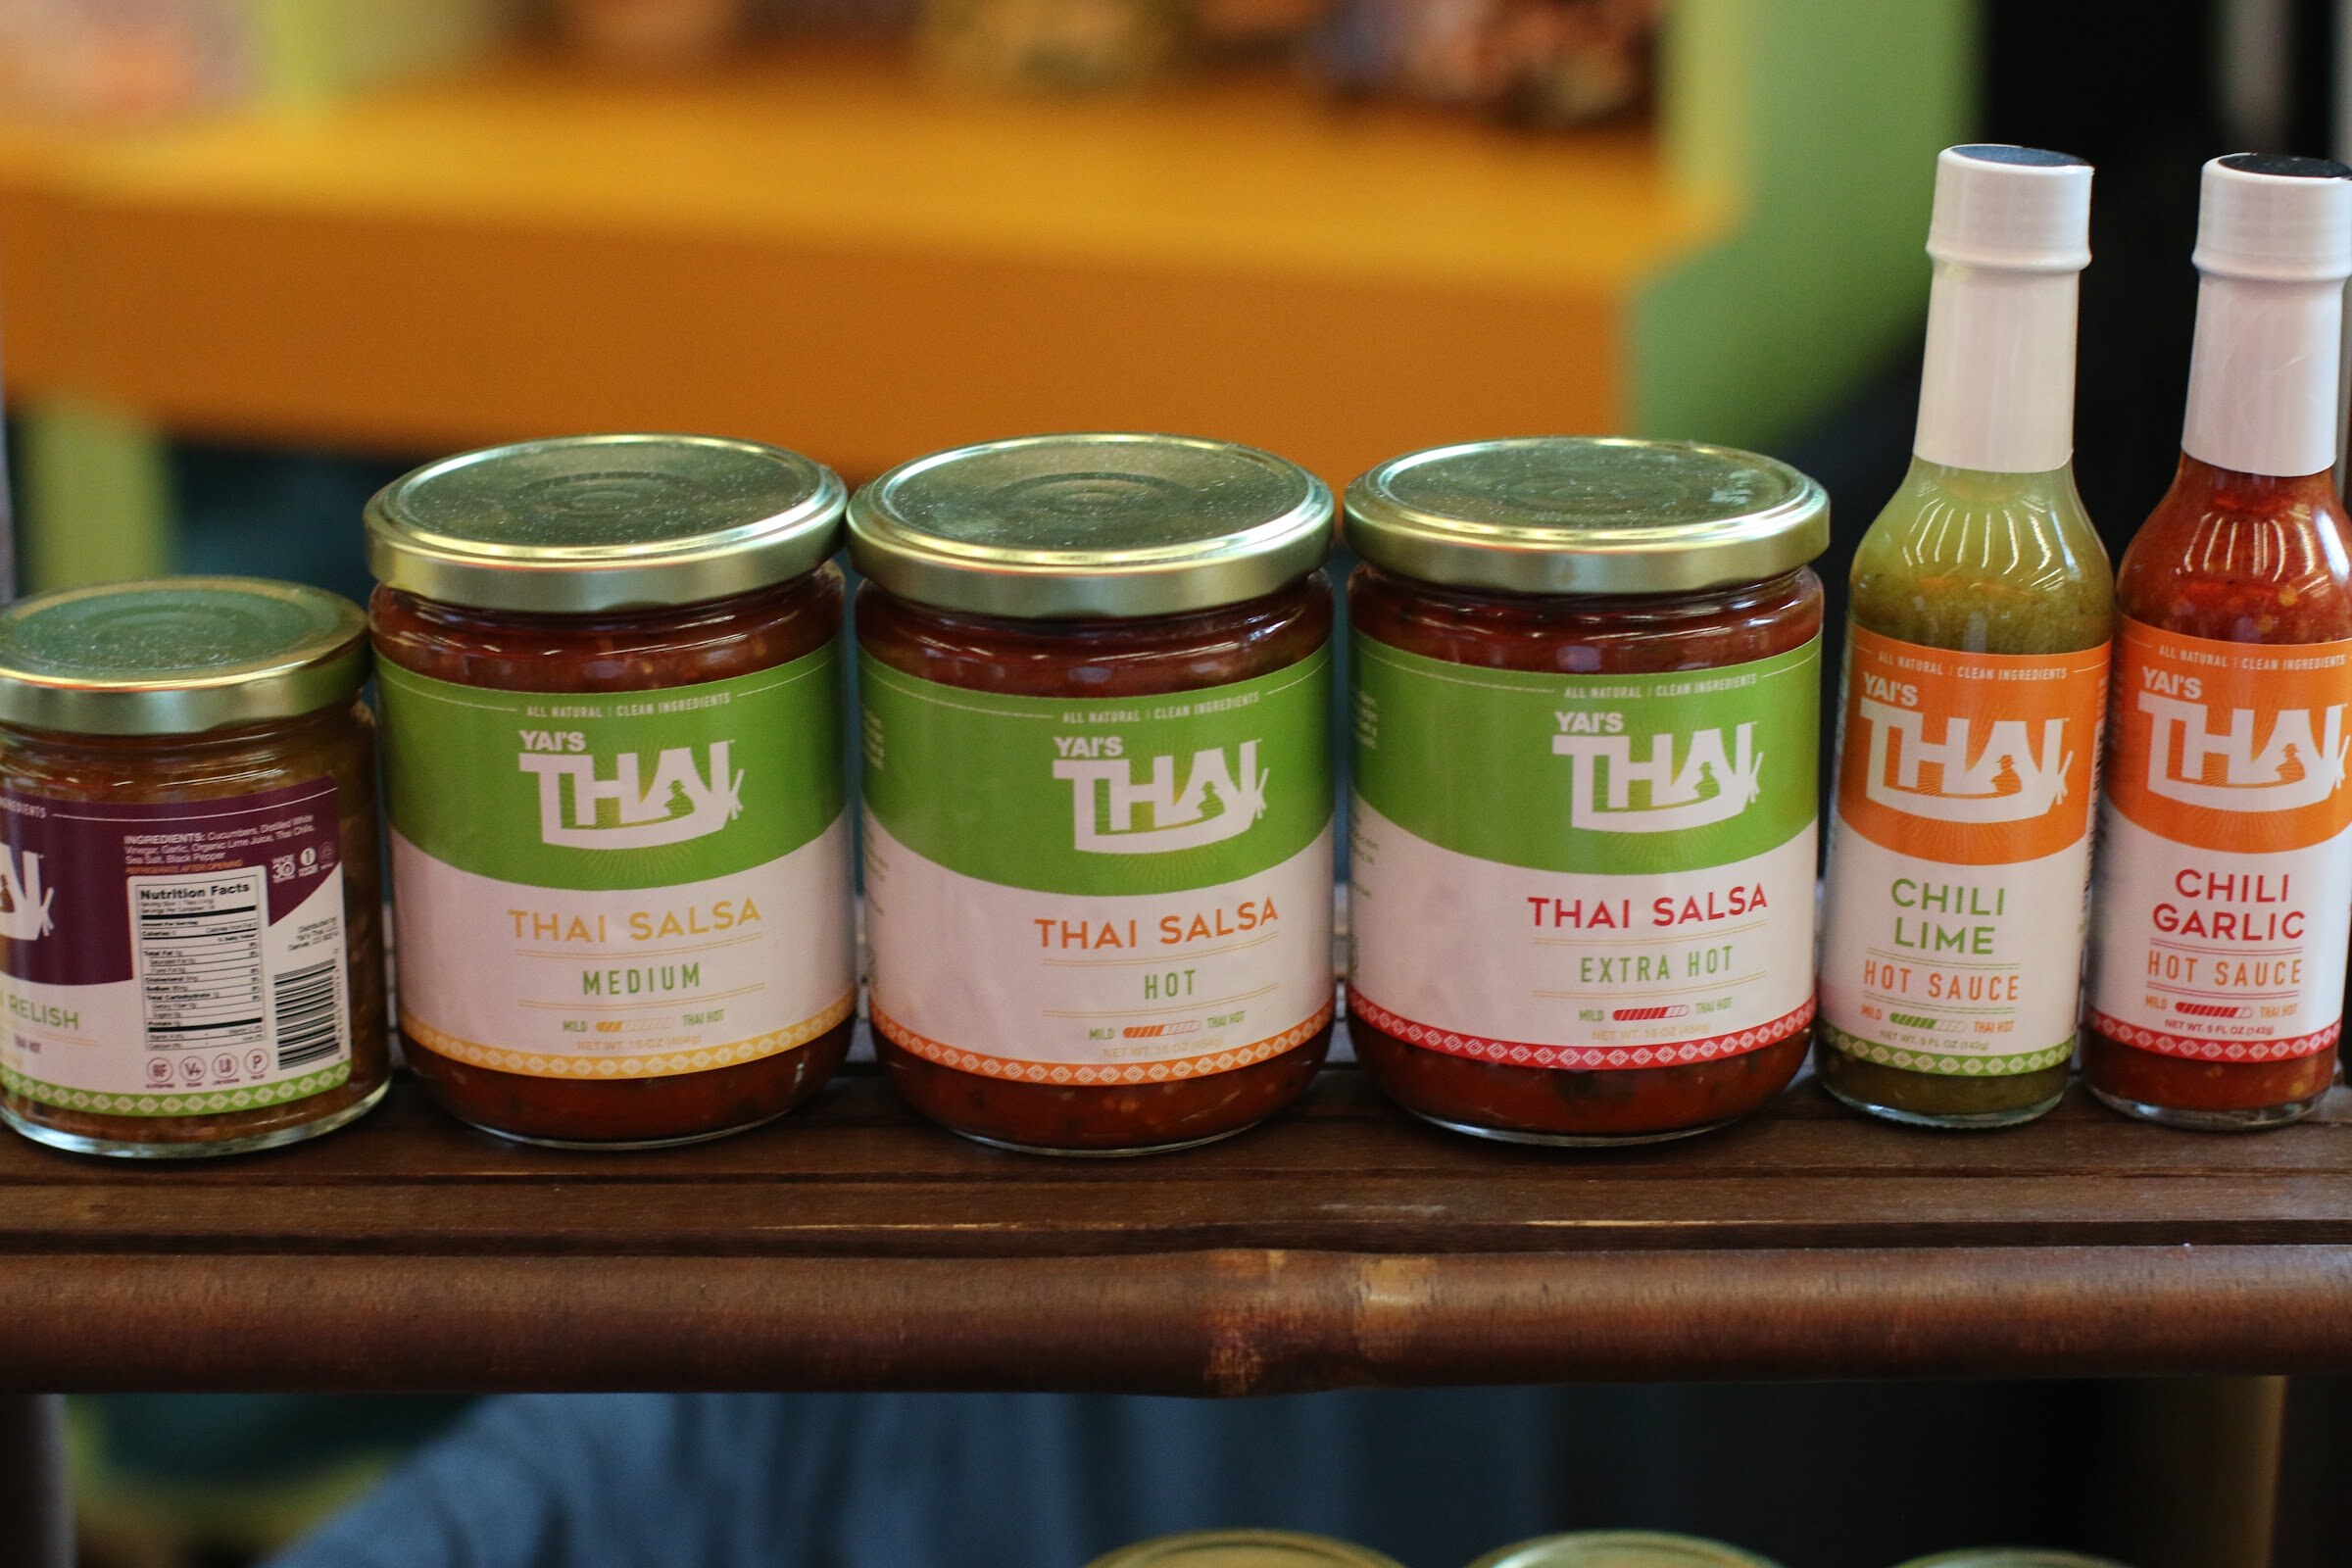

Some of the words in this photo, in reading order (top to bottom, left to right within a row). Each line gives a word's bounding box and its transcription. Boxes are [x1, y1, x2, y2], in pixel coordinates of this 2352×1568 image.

[1877, 651, 1894, 666] ALL
[1896, 656, 1944, 676] NATURAL
[1956, 665, 1994, 680] CLEAN
[1998, 667, 2068, 681] INGREDIENTS
[2159, 645, 2176, 660] ALL
[2179, 649, 2229, 668] NATURAL
[2241, 658, 2278, 670] CLEAN
[2282, 654, 2346, 670] INGREDIENTS
[1564, 686, 1586, 699] ALL
[1591, 686, 1642, 699] NATURAL
[1655, 682, 1690, 698] CLEAN
[1693, 673, 1757, 694] INGREDIENTS
[1862, 671, 1919, 707] YAI'S
[2141, 665, 2203, 700] YAI'S
[526, 705, 548, 718] ALL
[551, 706, 603, 718] NATURAL
[615, 702, 655, 716] CLEAN
[658, 692, 731, 713] INGREDIENTS
[1063, 711, 1085, 723] ALL
[1089, 710, 1141, 723] NATURAL
[1153, 705, 1191, 720] CLEAN
[1194, 691, 1259, 714] INGREDIENTS
[1554, 710, 1624, 733] YAI'S
[518, 729, 586, 752] YAI'S
[1053, 736, 1124, 758] YAI'S
[2137, 690, 2349, 812] THAI
[1552, 721, 1762, 833] THAI
[1859, 697, 2073, 823] THAI
[518, 739, 742, 850] THAI
[1053, 739, 1267, 855] THAI
[140, 888, 205, 900] Nutrition
[210, 883, 251, 896] Facts
[1890, 878, 2005, 916] CHILI
[2175, 868, 2289, 903] CHILI
[507, 908, 606, 943] THAI
[628, 897, 761, 941] SALSA
[1527, 897, 1630, 929] THAI
[1651, 882, 1768, 927] SALSA
[2153, 903, 2305, 941] GARLIC
[1034, 918, 1137, 950] THAI
[1159, 897, 1279, 945] SALSA
[1894, 916, 1995, 955] LIME
[582, 961, 701, 996] MEDIUM
[1580, 955, 1670, 984] EXTRA
[1688, 946, 1734, 978] HOT
[1864, 958, 1913, 994] HOT
[1928, 972, 2021, 1002] SAUCE
[2148, 950, 2198, 983] HOT
[2215, 958, 2302, 987] SAUCE
[1144, 968, 1197, 1001] HOT
[9, 994, 79, 1030] RELISH
[1579, 1009, 1605, 1022] MILD
[1695, 1002, 1715, 1014] THAI
[1716, 996, 1734, 1010] HOT
[1860, 1004, 1884, 1021] MILD
[1974, 1020, 1996, 1034] THAI
[1996, 1019, 2016, 1033] HOT
[2144, 994, 2168, 1010] MILD
[2259, 1005, 2280, 1019] THAI
[2280, 1003, 2298, 1016] HOT
[562, 1019, 588, 1033] MILD
[1089, 1028, 1115, 1041] MILD
[1206, 1013, 1228, 1029] THAI
[1229, 1009, 1247, 1025] HOT
[1591, 1030, 1616, 1041] NET
[1878, 1029, 1898, 1042] NET
[1928, 1037, 1940, 1048] FL
[1942, 1039, 1958, 1049] OZ
[2164, 1019, 2184, 1030] NET
[2215, 1024, 2228, 1034] FL
[2230, 1025, 2244, 1035] OZ
